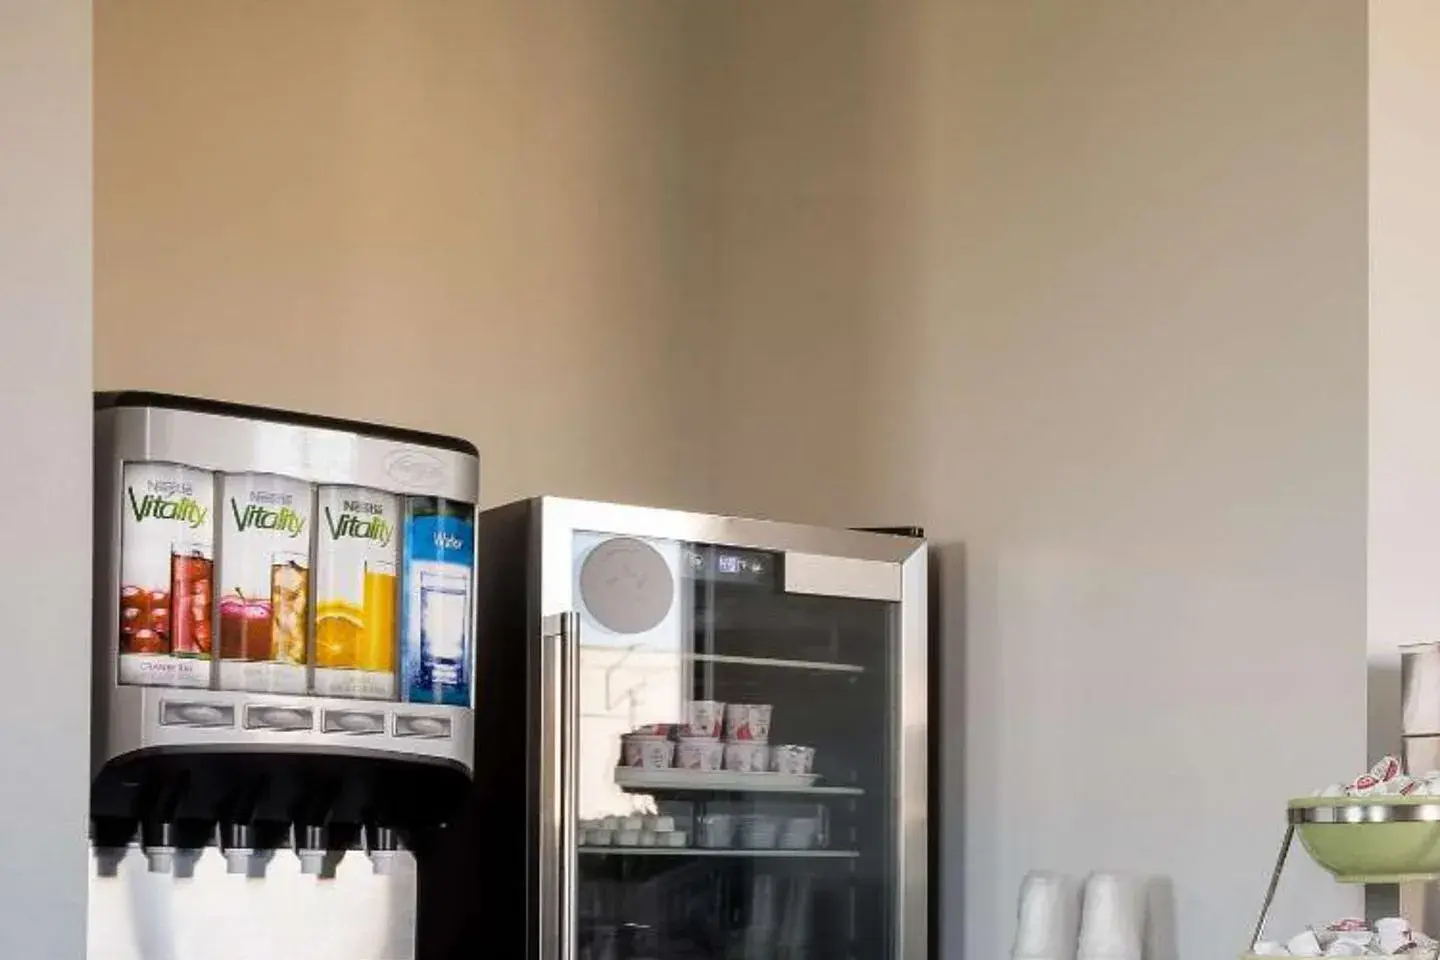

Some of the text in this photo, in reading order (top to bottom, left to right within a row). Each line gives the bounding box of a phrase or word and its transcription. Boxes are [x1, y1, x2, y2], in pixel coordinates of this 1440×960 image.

[128, 486, 207, 529] Vitality
[231, 496, 305, 538] Vitality
[325, 506, 393, 548] Vitality
